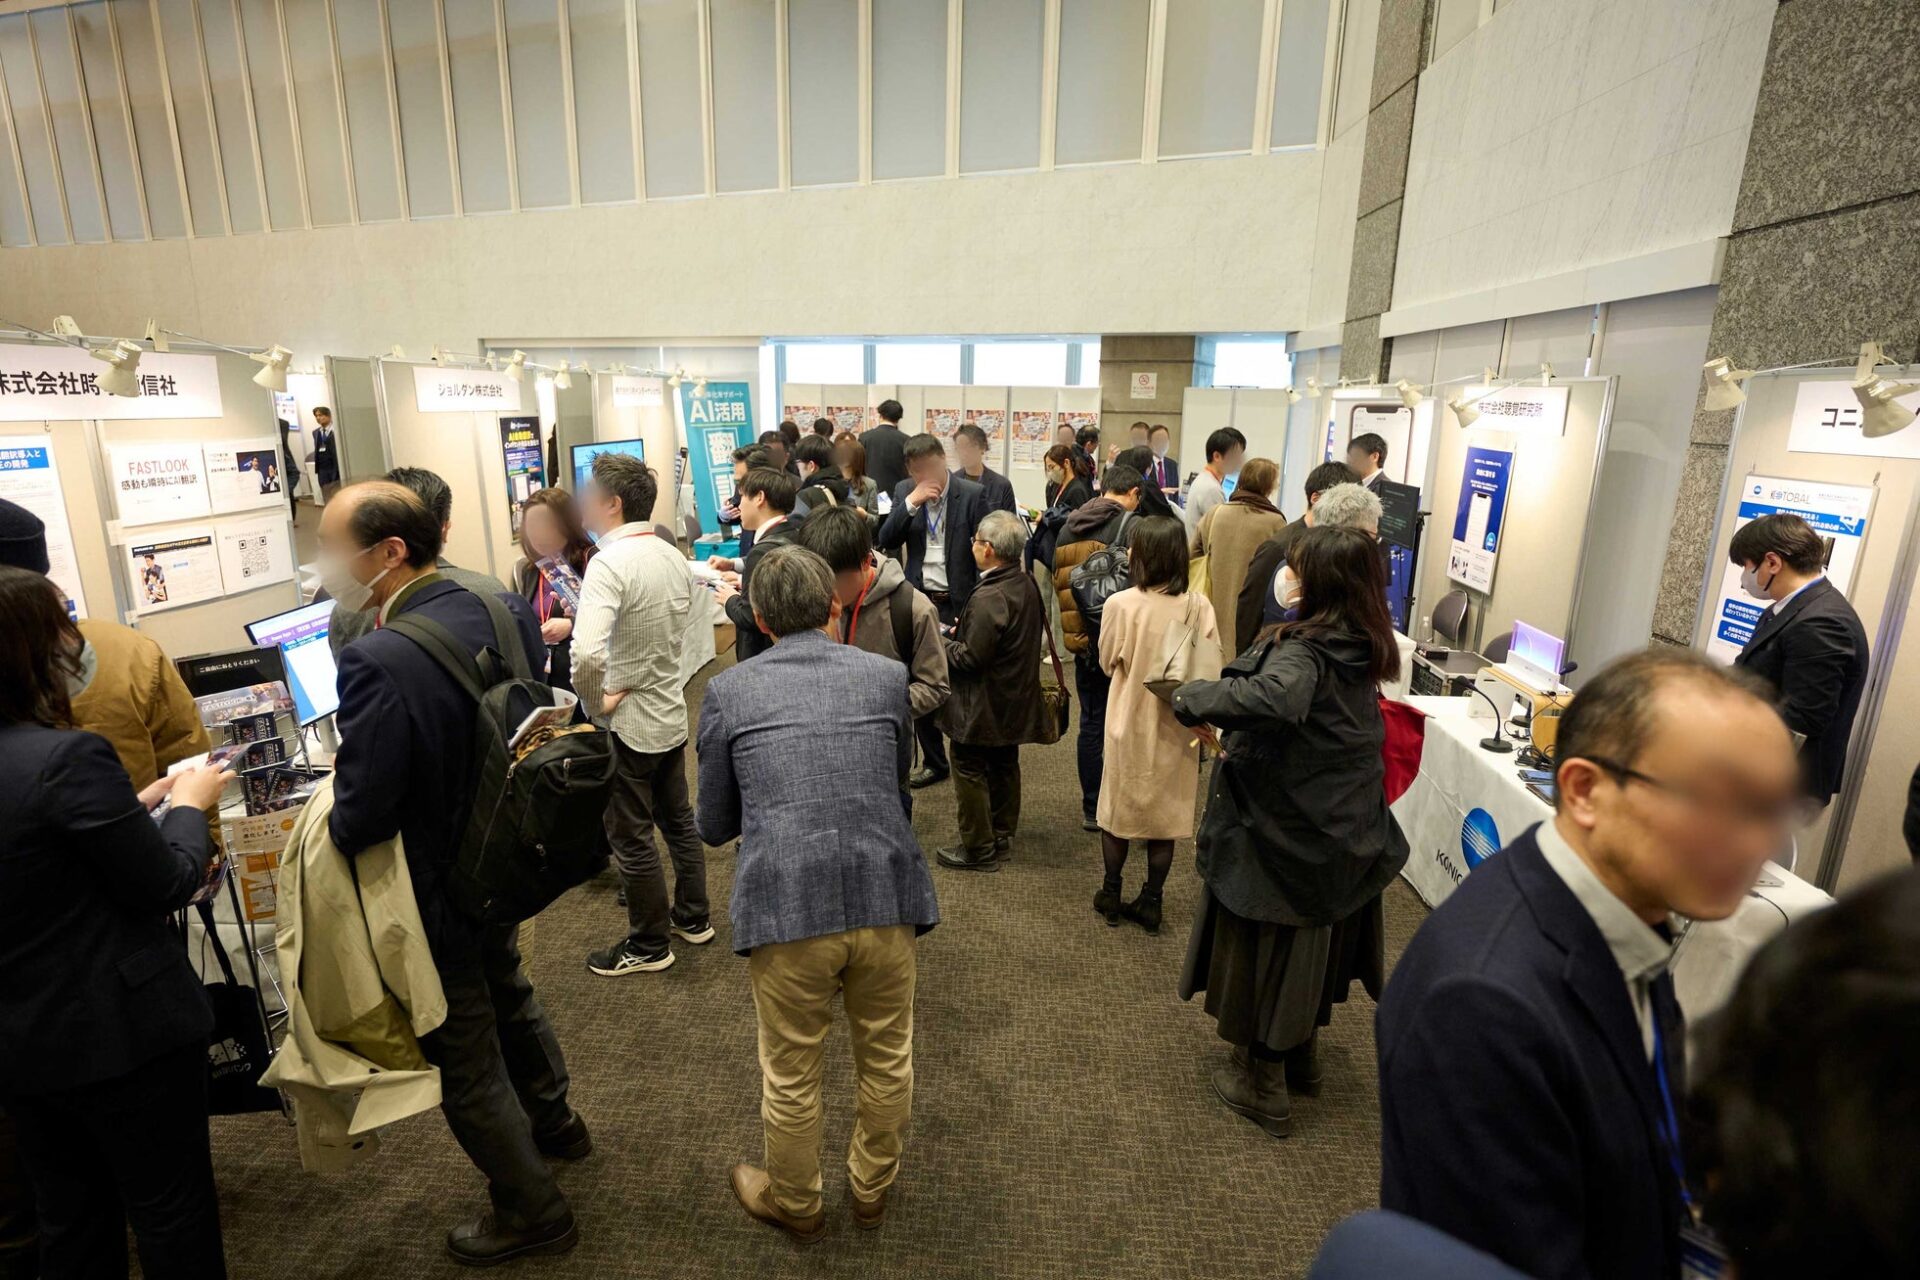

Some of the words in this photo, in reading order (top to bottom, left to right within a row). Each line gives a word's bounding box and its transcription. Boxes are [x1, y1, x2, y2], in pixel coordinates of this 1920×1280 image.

[0, 370, 178, 396] 式会社時信社
[438, 383, 503, 397] ジョルダン株式会社
[690, 399, 746, 423] AI活用
[128, 459, 189, 475] FASTLOOK
[121, 474, 198, 491] 感動も瞬時にAI翻訳
[199, 658, 260, 673] ご自由におとりください
[1435, 849, 1463, 887] KONIC
